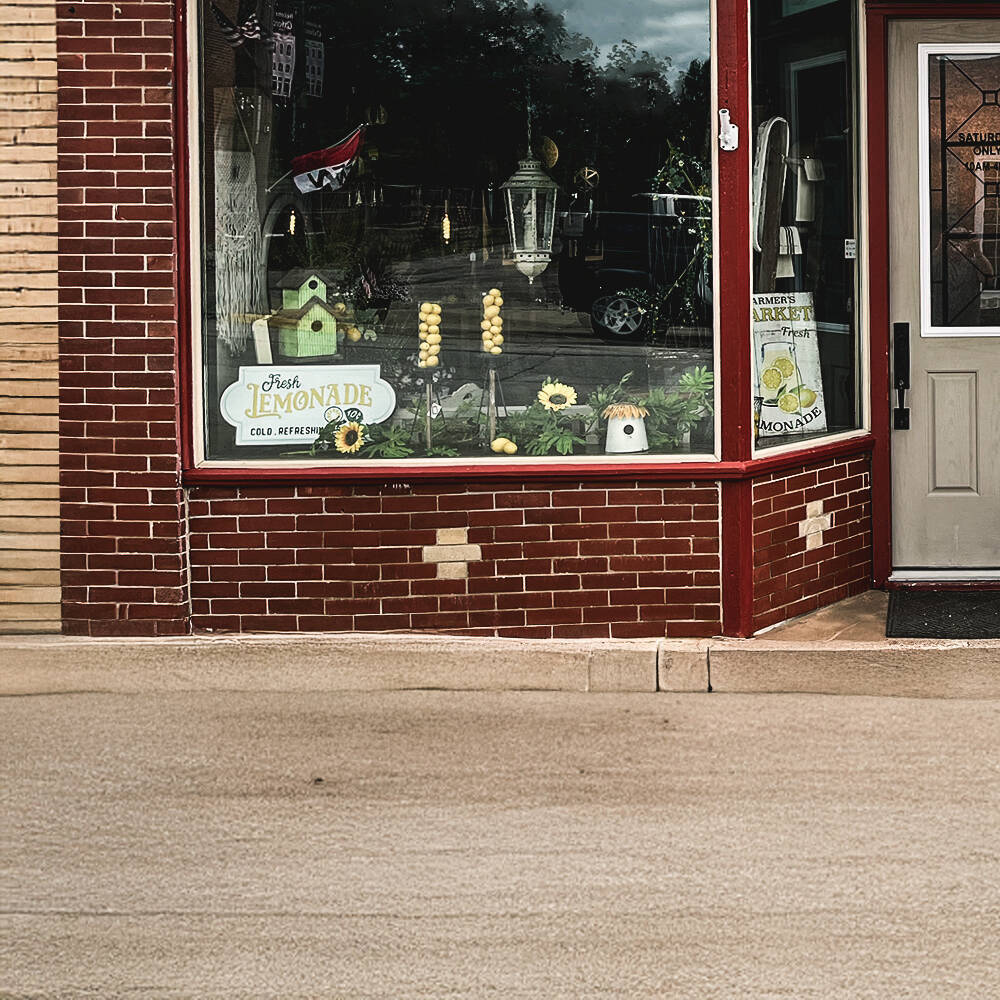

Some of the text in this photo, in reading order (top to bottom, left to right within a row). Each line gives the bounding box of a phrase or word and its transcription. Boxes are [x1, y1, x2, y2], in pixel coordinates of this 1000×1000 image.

[753, 296, 796, 306] ARMER'S
[753, 305, 812, 322] ARKET
[781, 326, 811, 340] Fresh
[262, 373, 302, 392] Fresh
[244, 383, 373, 419] LEMONADE
[760, 406, 822, 432] MONADE
[278, 426, 324, 437] REFRESHI
